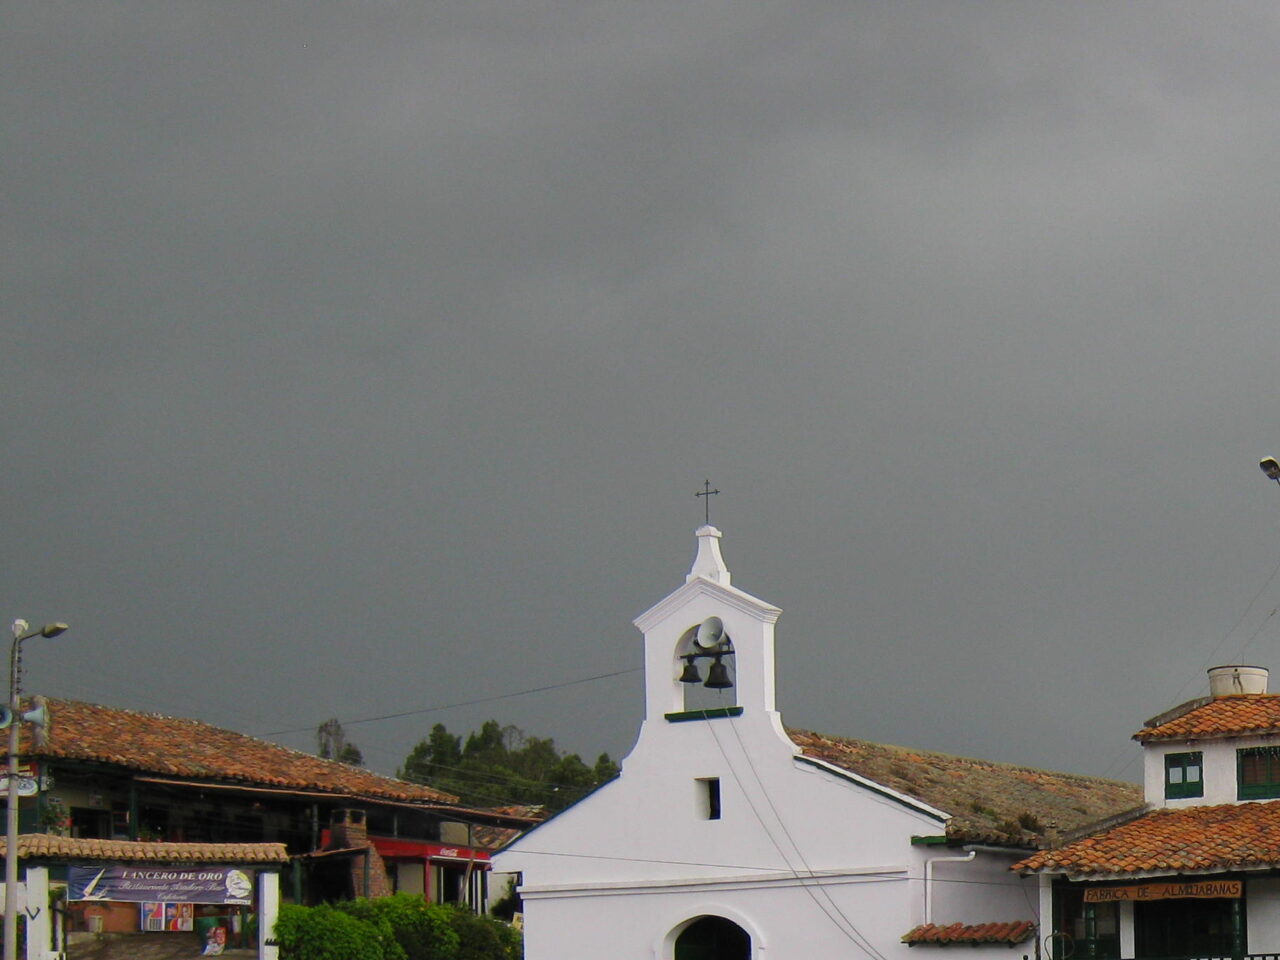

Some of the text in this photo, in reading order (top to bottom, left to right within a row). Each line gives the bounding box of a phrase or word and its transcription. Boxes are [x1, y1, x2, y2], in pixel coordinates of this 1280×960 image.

[122, 871, 223, 881] LANCERO DE ORO
[1136, 887, 1149, 898] DE
